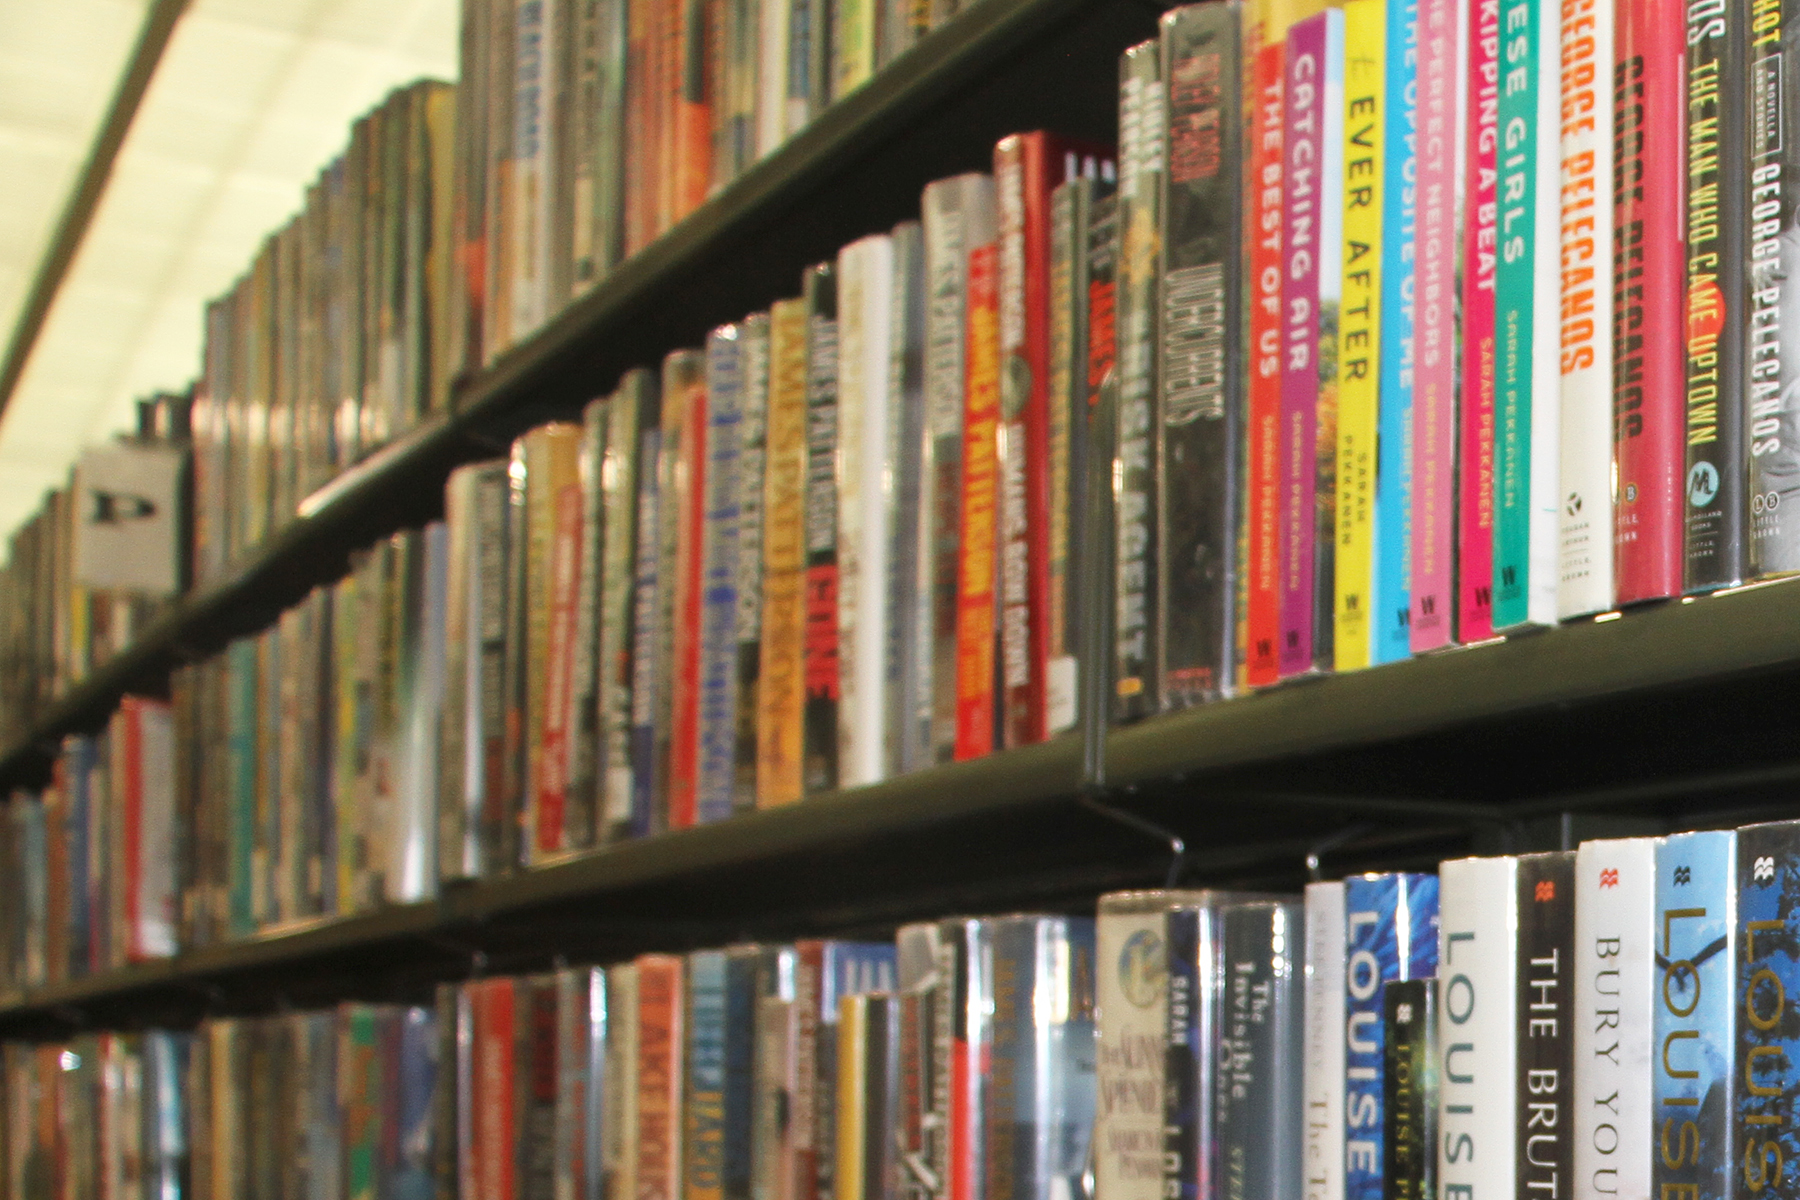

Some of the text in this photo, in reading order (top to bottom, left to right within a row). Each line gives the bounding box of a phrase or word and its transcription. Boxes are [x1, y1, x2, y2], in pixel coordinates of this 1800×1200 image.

[1258, 78, 1283, 378] THE BEST OF US
[1289, 53, 1316, 372] CATCHING AIR
[1344, 96, 1375, 382] EVER AFTER
[1477, 203, 1497, 292] BEAT
[1503, 117, 1526, 264] GIRLS
[1751, 163, 1781, 457] GEORGE PELECANOS
[1231, 960, 1256, 1100] Invisible
[1346, 910, 1380, 1175] LOUISE
[1528, 949, 1560, 1038] THE
[1593, 936, 1621, 1066] BURY
[1307, 1092, 1330, 1162] The
